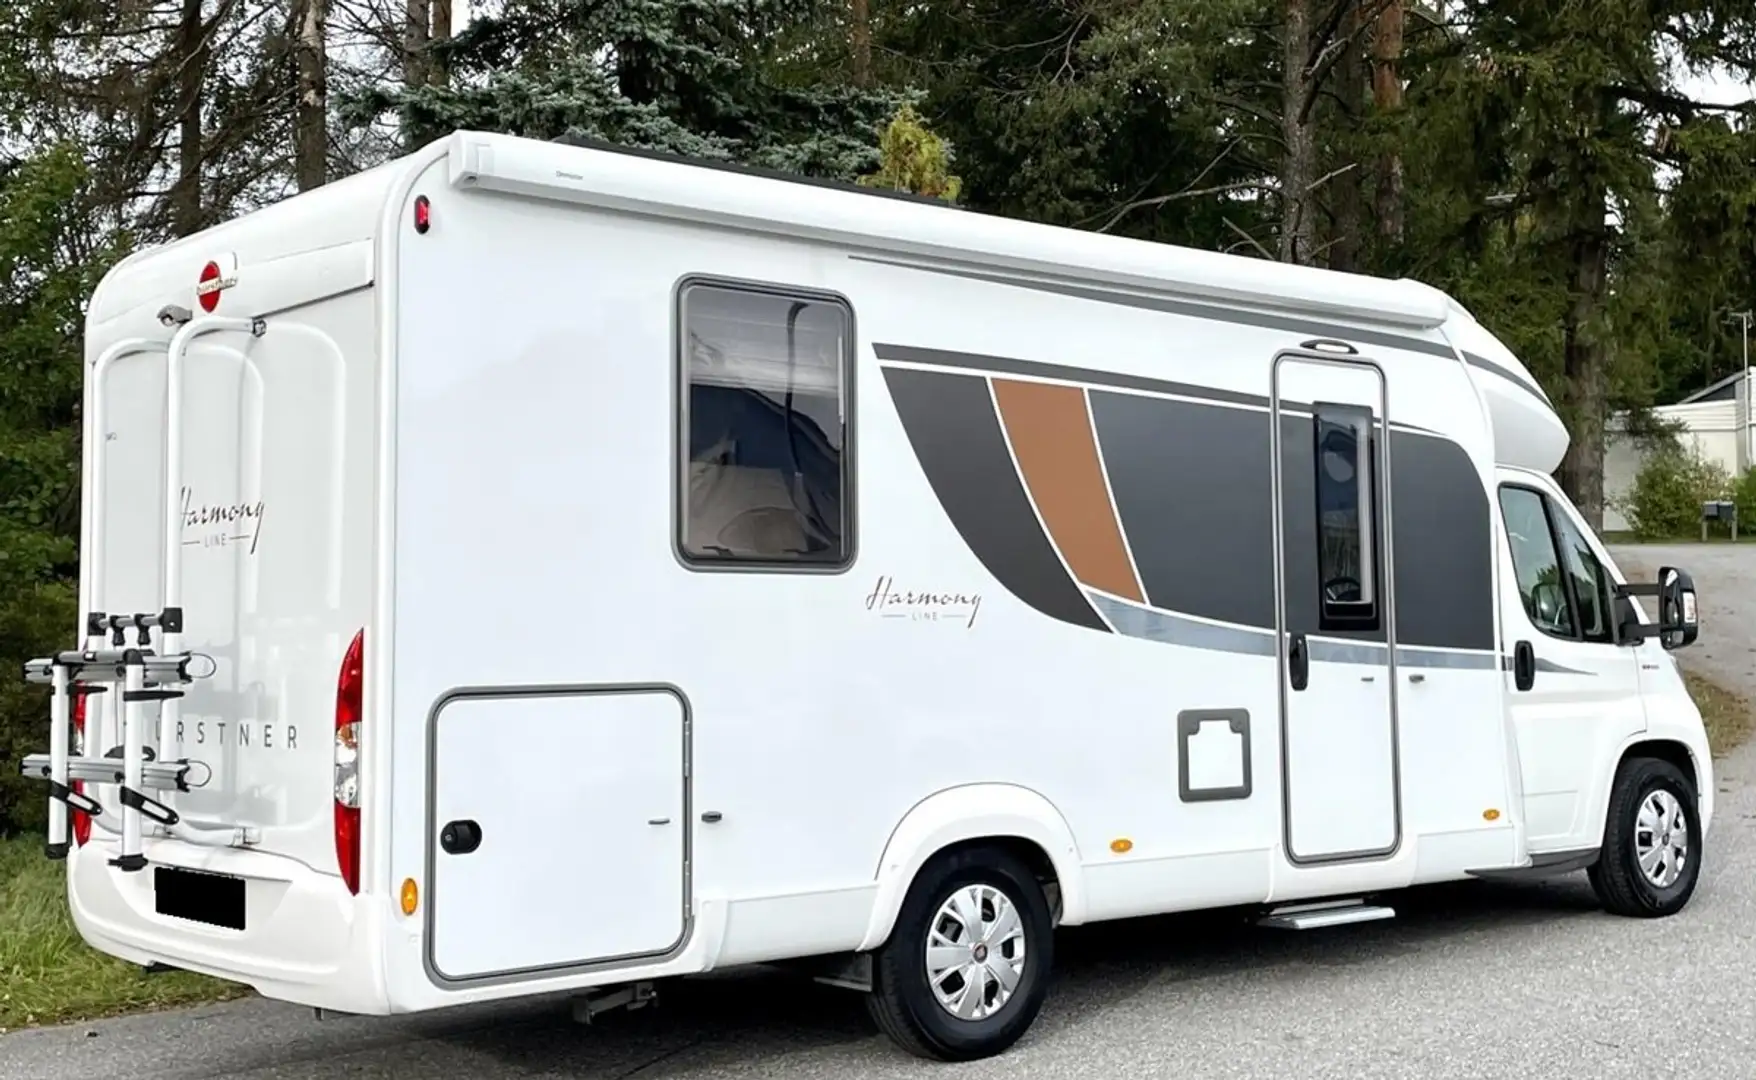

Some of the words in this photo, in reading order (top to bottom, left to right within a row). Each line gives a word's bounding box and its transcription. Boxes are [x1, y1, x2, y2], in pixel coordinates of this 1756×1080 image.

[180, 486, 264, 555] Harmony
[204, 533, 227, 548] LINE
[865, 575, 982, 628] Harmony
[911, 611, 938, 621] LINE
